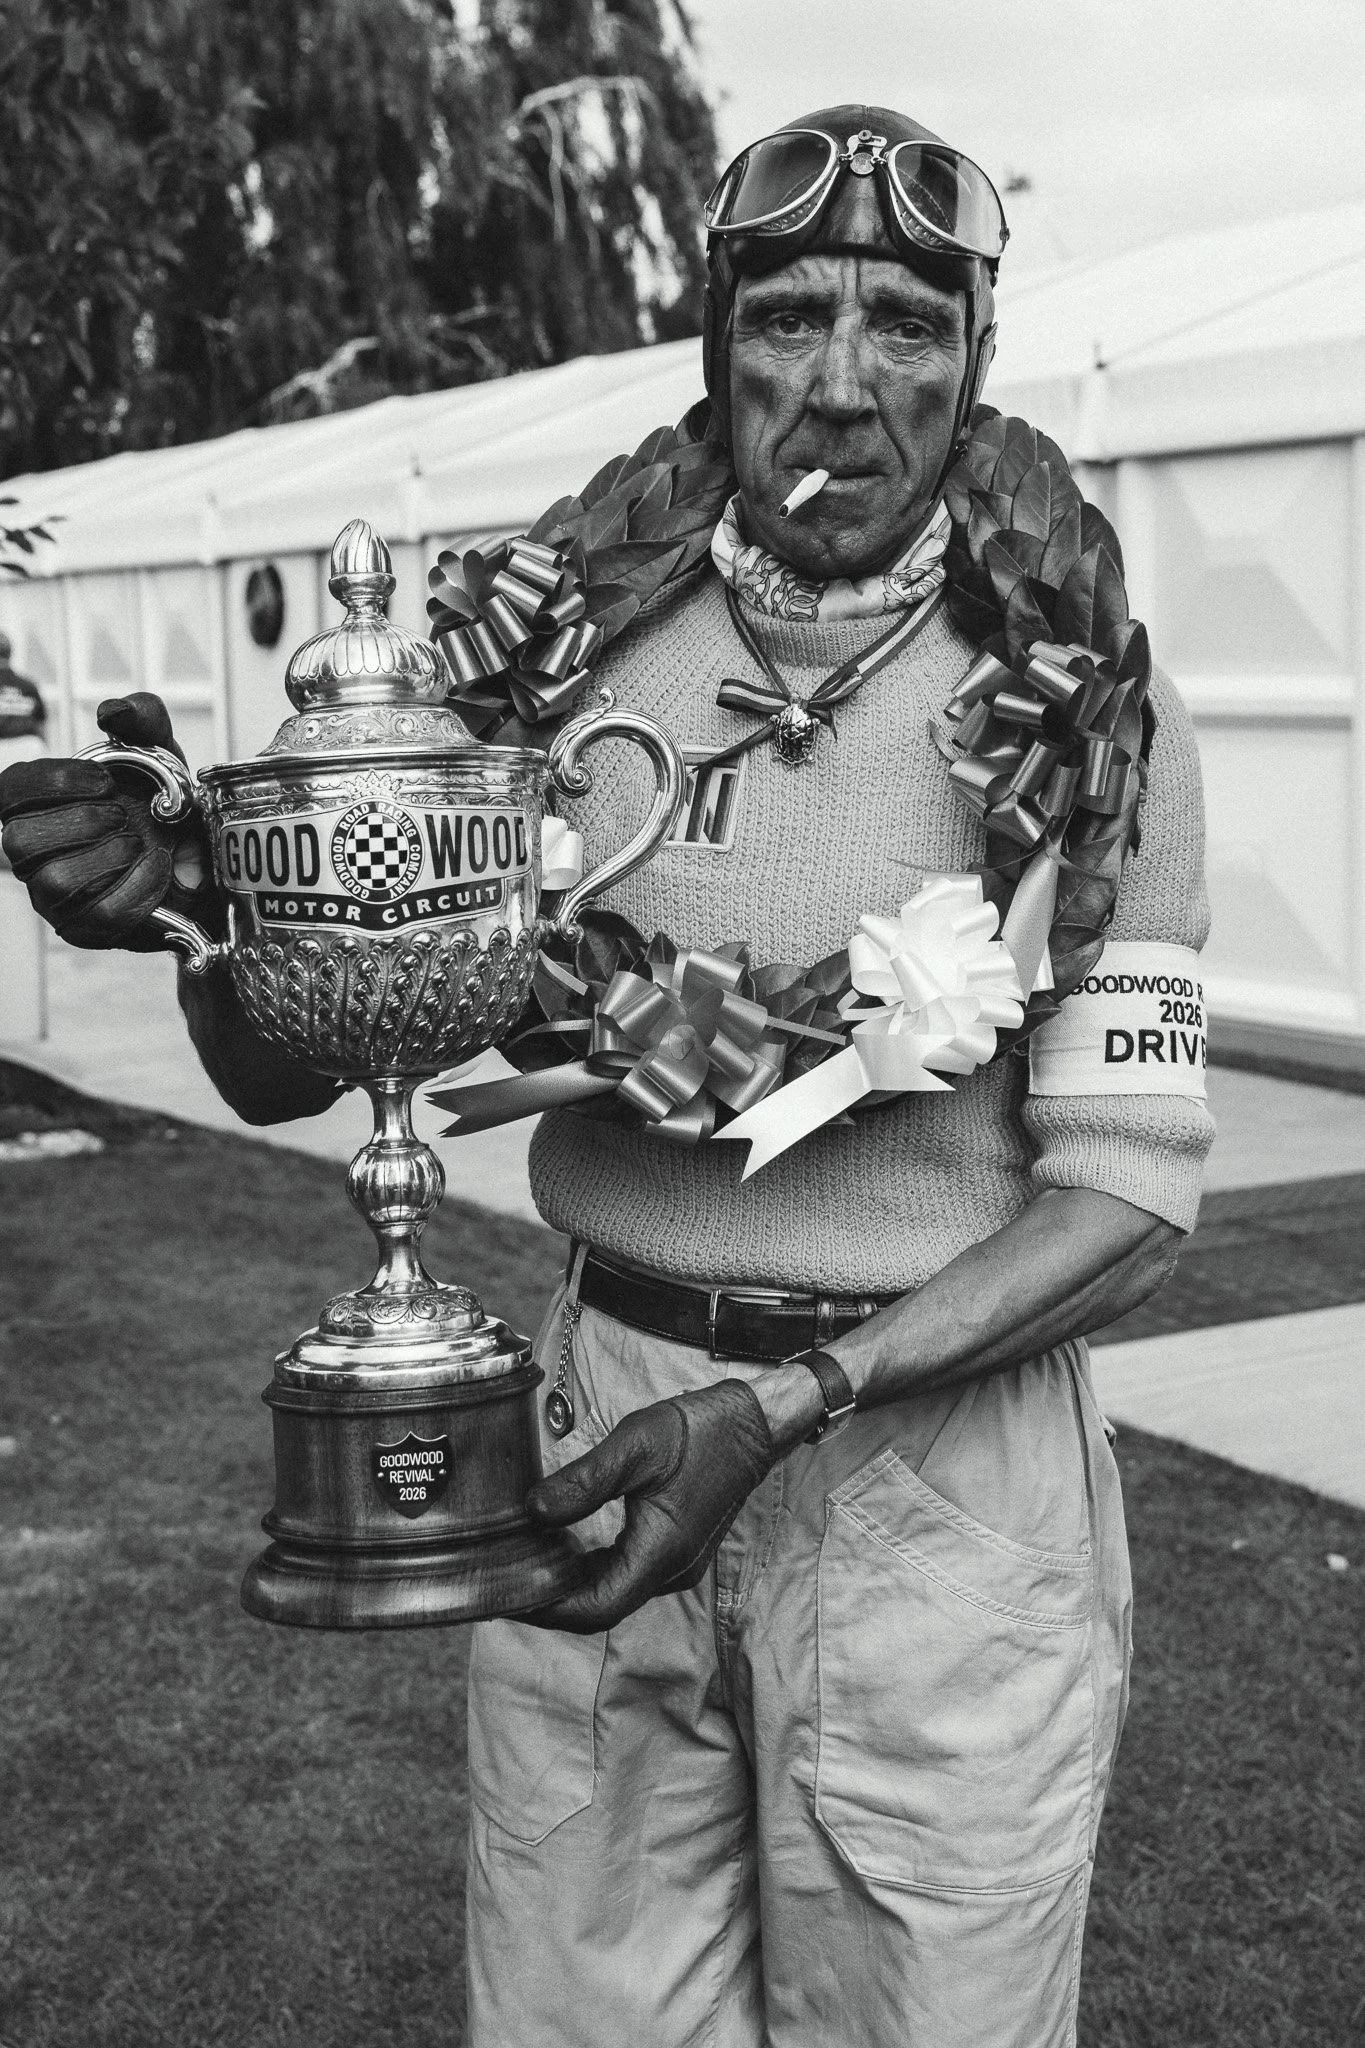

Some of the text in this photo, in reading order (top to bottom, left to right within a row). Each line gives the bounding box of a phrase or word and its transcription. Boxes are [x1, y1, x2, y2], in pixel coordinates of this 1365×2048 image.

[225, 813, 528, 887] GOOD WOOD
[332, 802, 421, 900] GOODWOOD ROAD RACING COMPANY
[264, 885, 499, 924] MOTOR CIRCUIT
[1159, 999, 1202, 1028] 2026
[380, 1451, 443, 1467] GOODWOOD
[389, 1469, 434, 1483] REVIVAL
[399, 1487, 426, 1500] 2026
